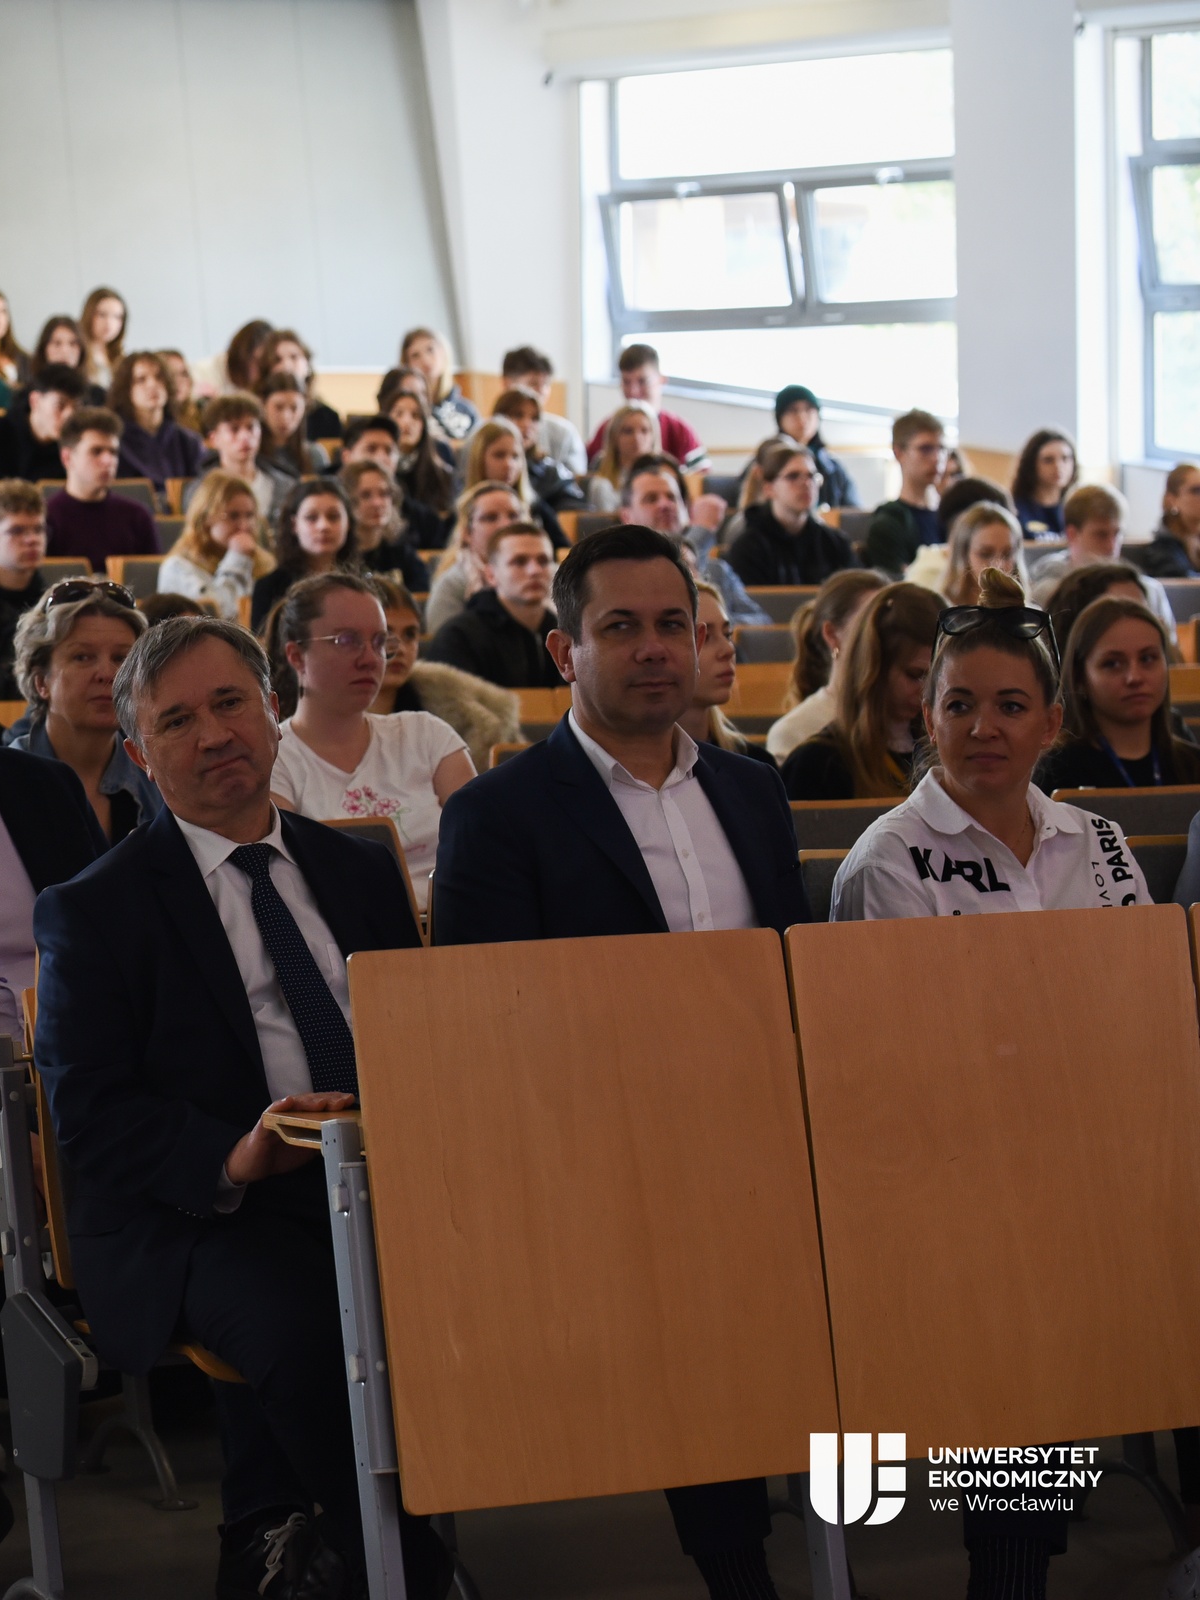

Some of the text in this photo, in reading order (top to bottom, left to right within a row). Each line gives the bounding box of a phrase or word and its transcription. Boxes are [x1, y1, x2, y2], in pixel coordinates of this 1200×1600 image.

[909, 846, 1011, 893] KARL
[1091, 818, 1133, 883] PARIS
[1091, 861, 1112, 907] LOV
